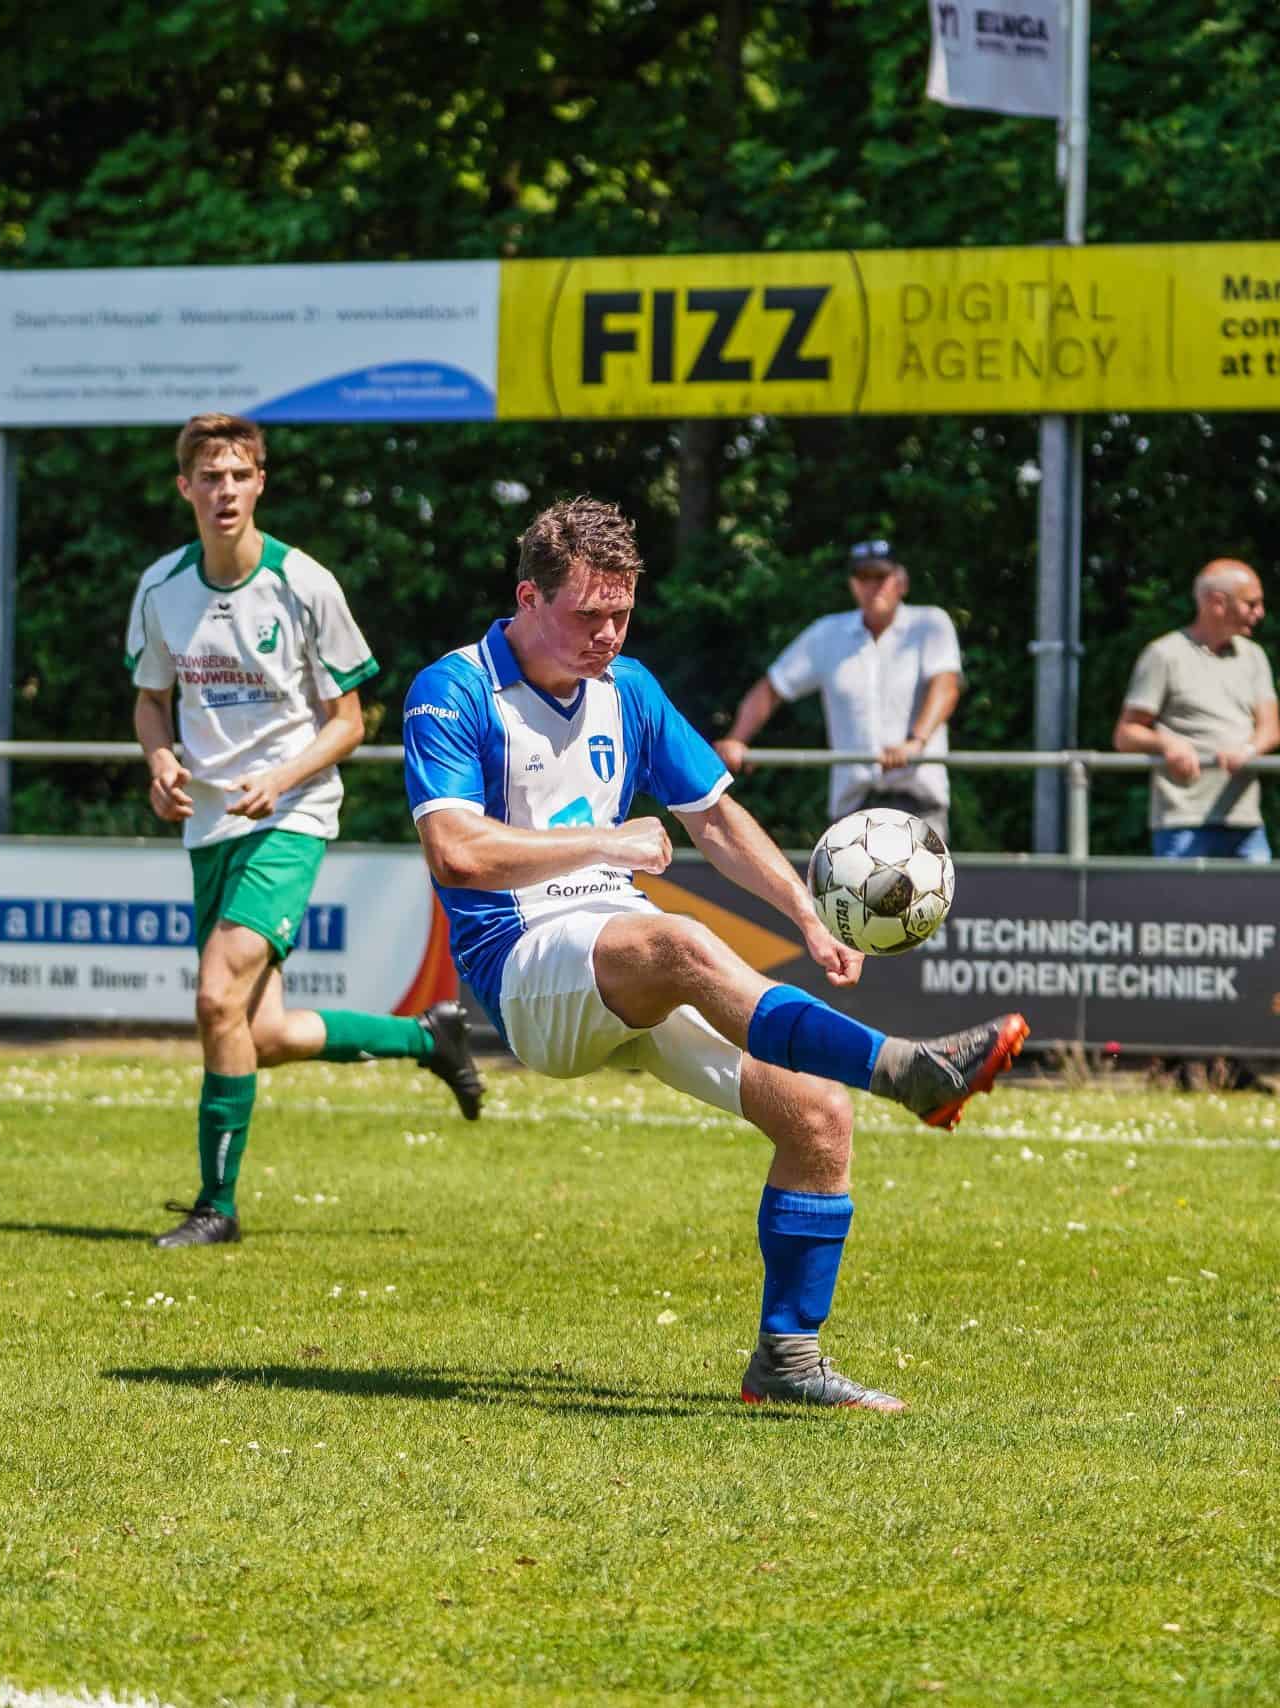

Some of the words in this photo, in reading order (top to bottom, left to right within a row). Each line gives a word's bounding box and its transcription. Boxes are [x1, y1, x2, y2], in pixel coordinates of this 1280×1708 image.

[900, 281, 1116, 325] DIGITAL
[580, 285, 832, 385] FIZZ
[895, 333, 1119, 383] AGENCY
[1221, 350, 1252, 376] at
[177, 656, 240, 669] OUWBEDRIJF
[954, 918, 1133, 954] TECHNISCH
[1140, 922, 1277, 959] BEDRIJF
[922, 960, 1239, 999] MOTORENTECHNIEK
